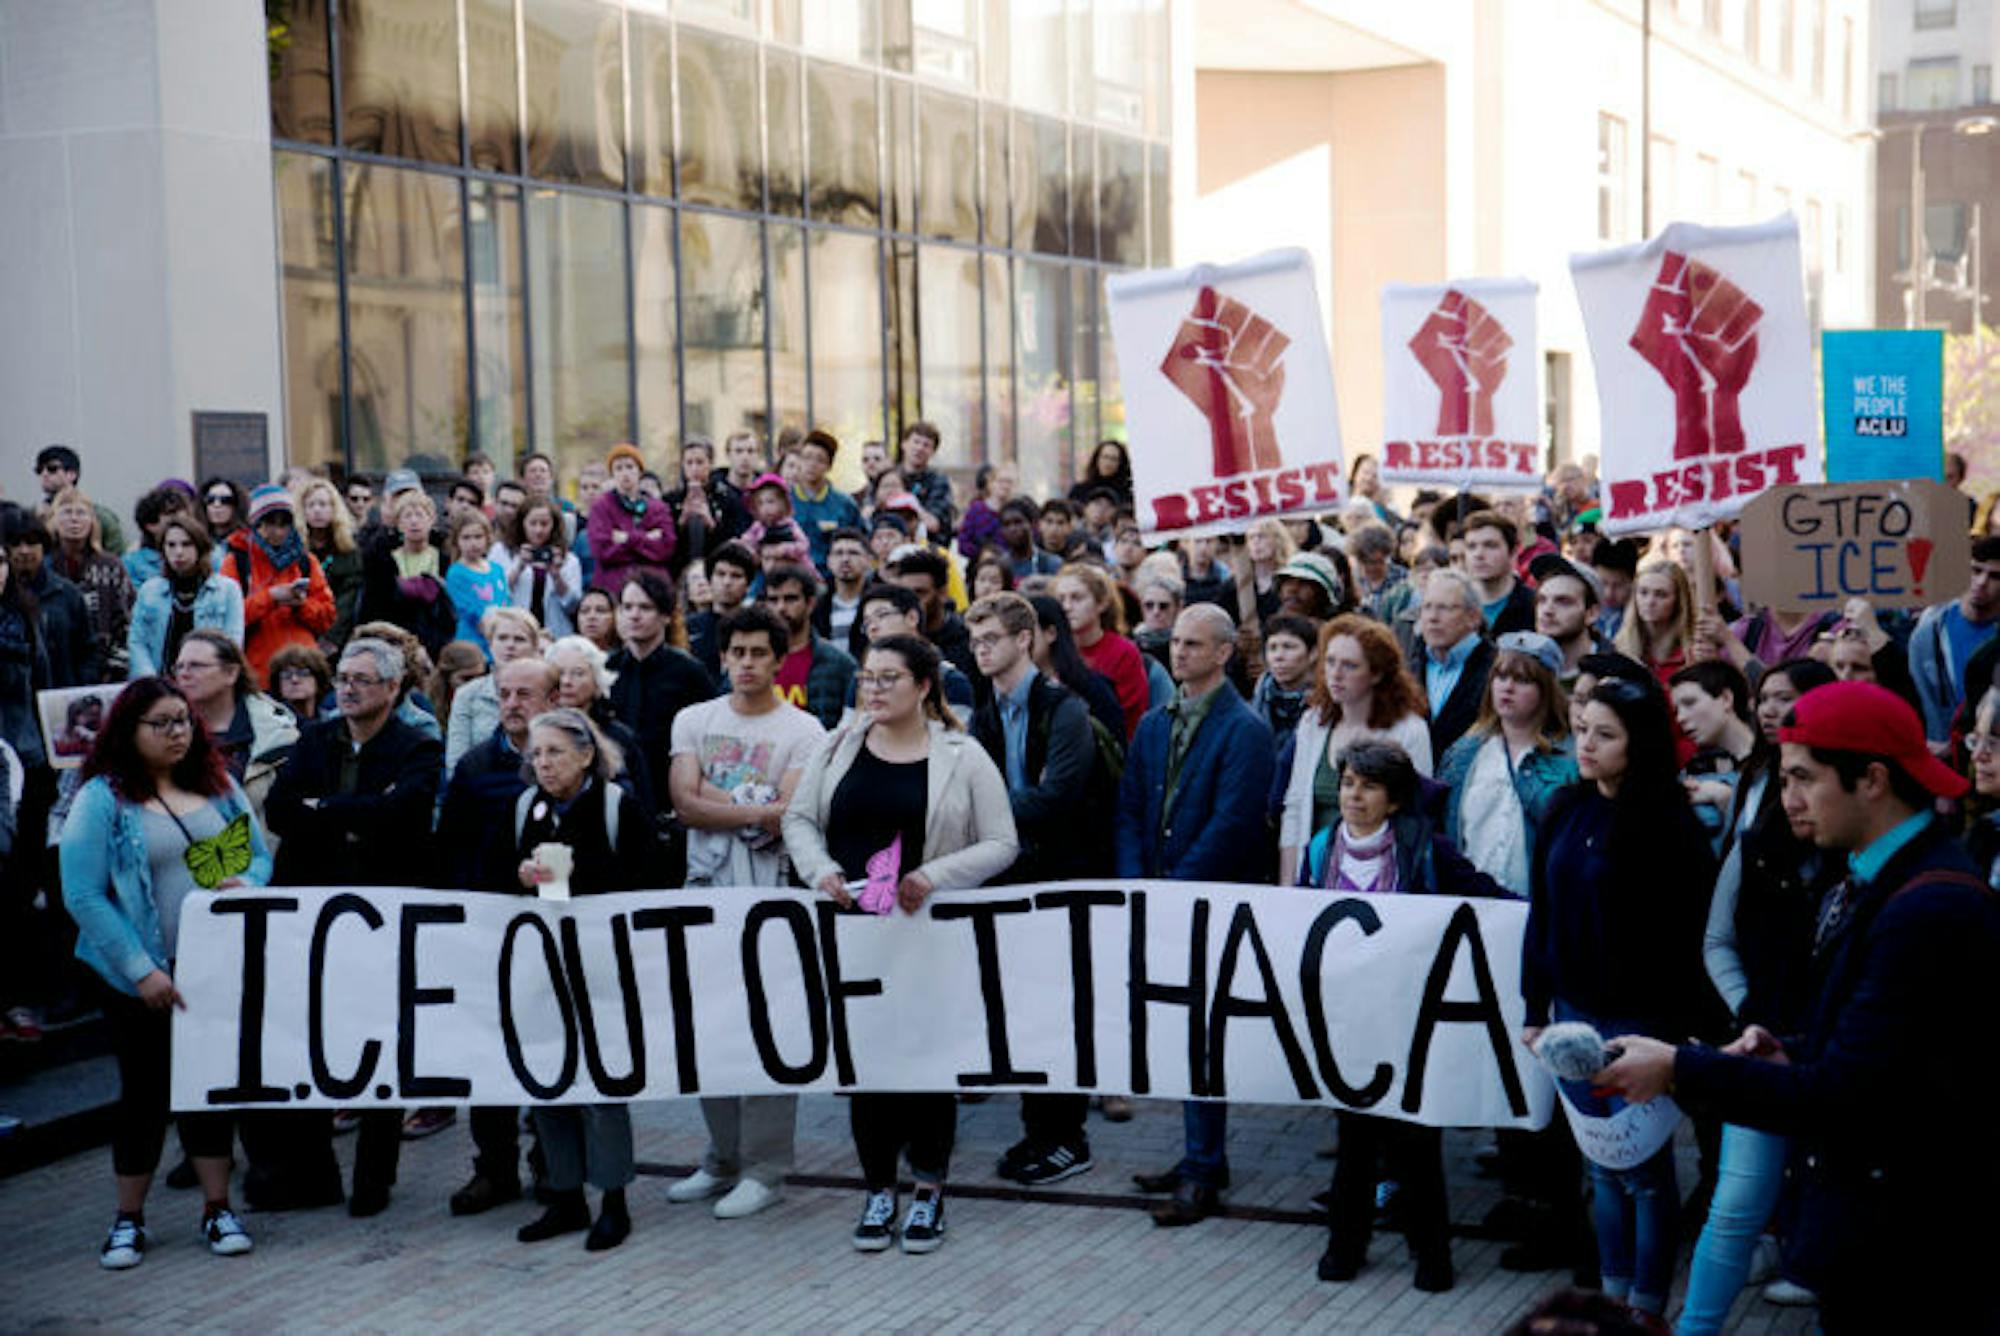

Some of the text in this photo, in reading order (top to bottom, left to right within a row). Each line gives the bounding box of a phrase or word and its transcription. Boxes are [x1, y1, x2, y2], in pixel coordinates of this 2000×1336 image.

[1853, 396, 1907, 415] PEOPLE
[1854, 375, 1907, 395] WE THE
[1856, 418, 1906, 435] ACLU
[1385, 438, 1537, 474] RESIST
[1151, 461, 1340, 532] RESIST
[1607, 444, 1806, 520] RESIST
[1782, 493, 1913, 538] GTFO
[1796, 537, 1934, 602] ICE!
[206, 889, 1530, 1117] I.C.E OUT OF ITHACA
